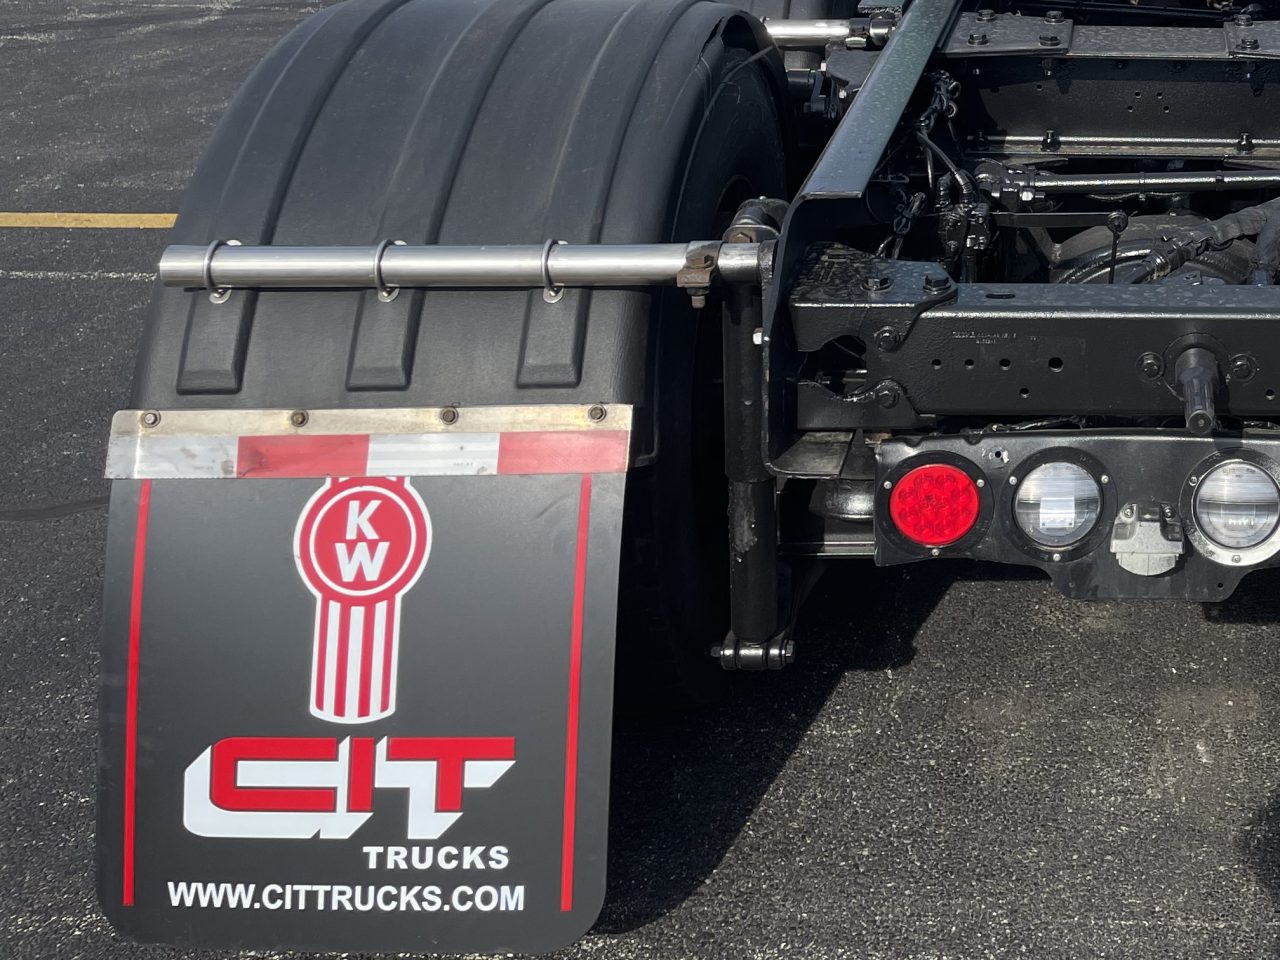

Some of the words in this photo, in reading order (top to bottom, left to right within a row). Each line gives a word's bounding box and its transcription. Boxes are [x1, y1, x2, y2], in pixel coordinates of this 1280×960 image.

[345, 499, 383, 541] K
[334, 541, 391, 583] W
[183, 736, 517, 840] CIT
[362, 845, 510, 870] TRUCKS
[167, 881, 526, 912] WWW.CITTRUCKS.COM
